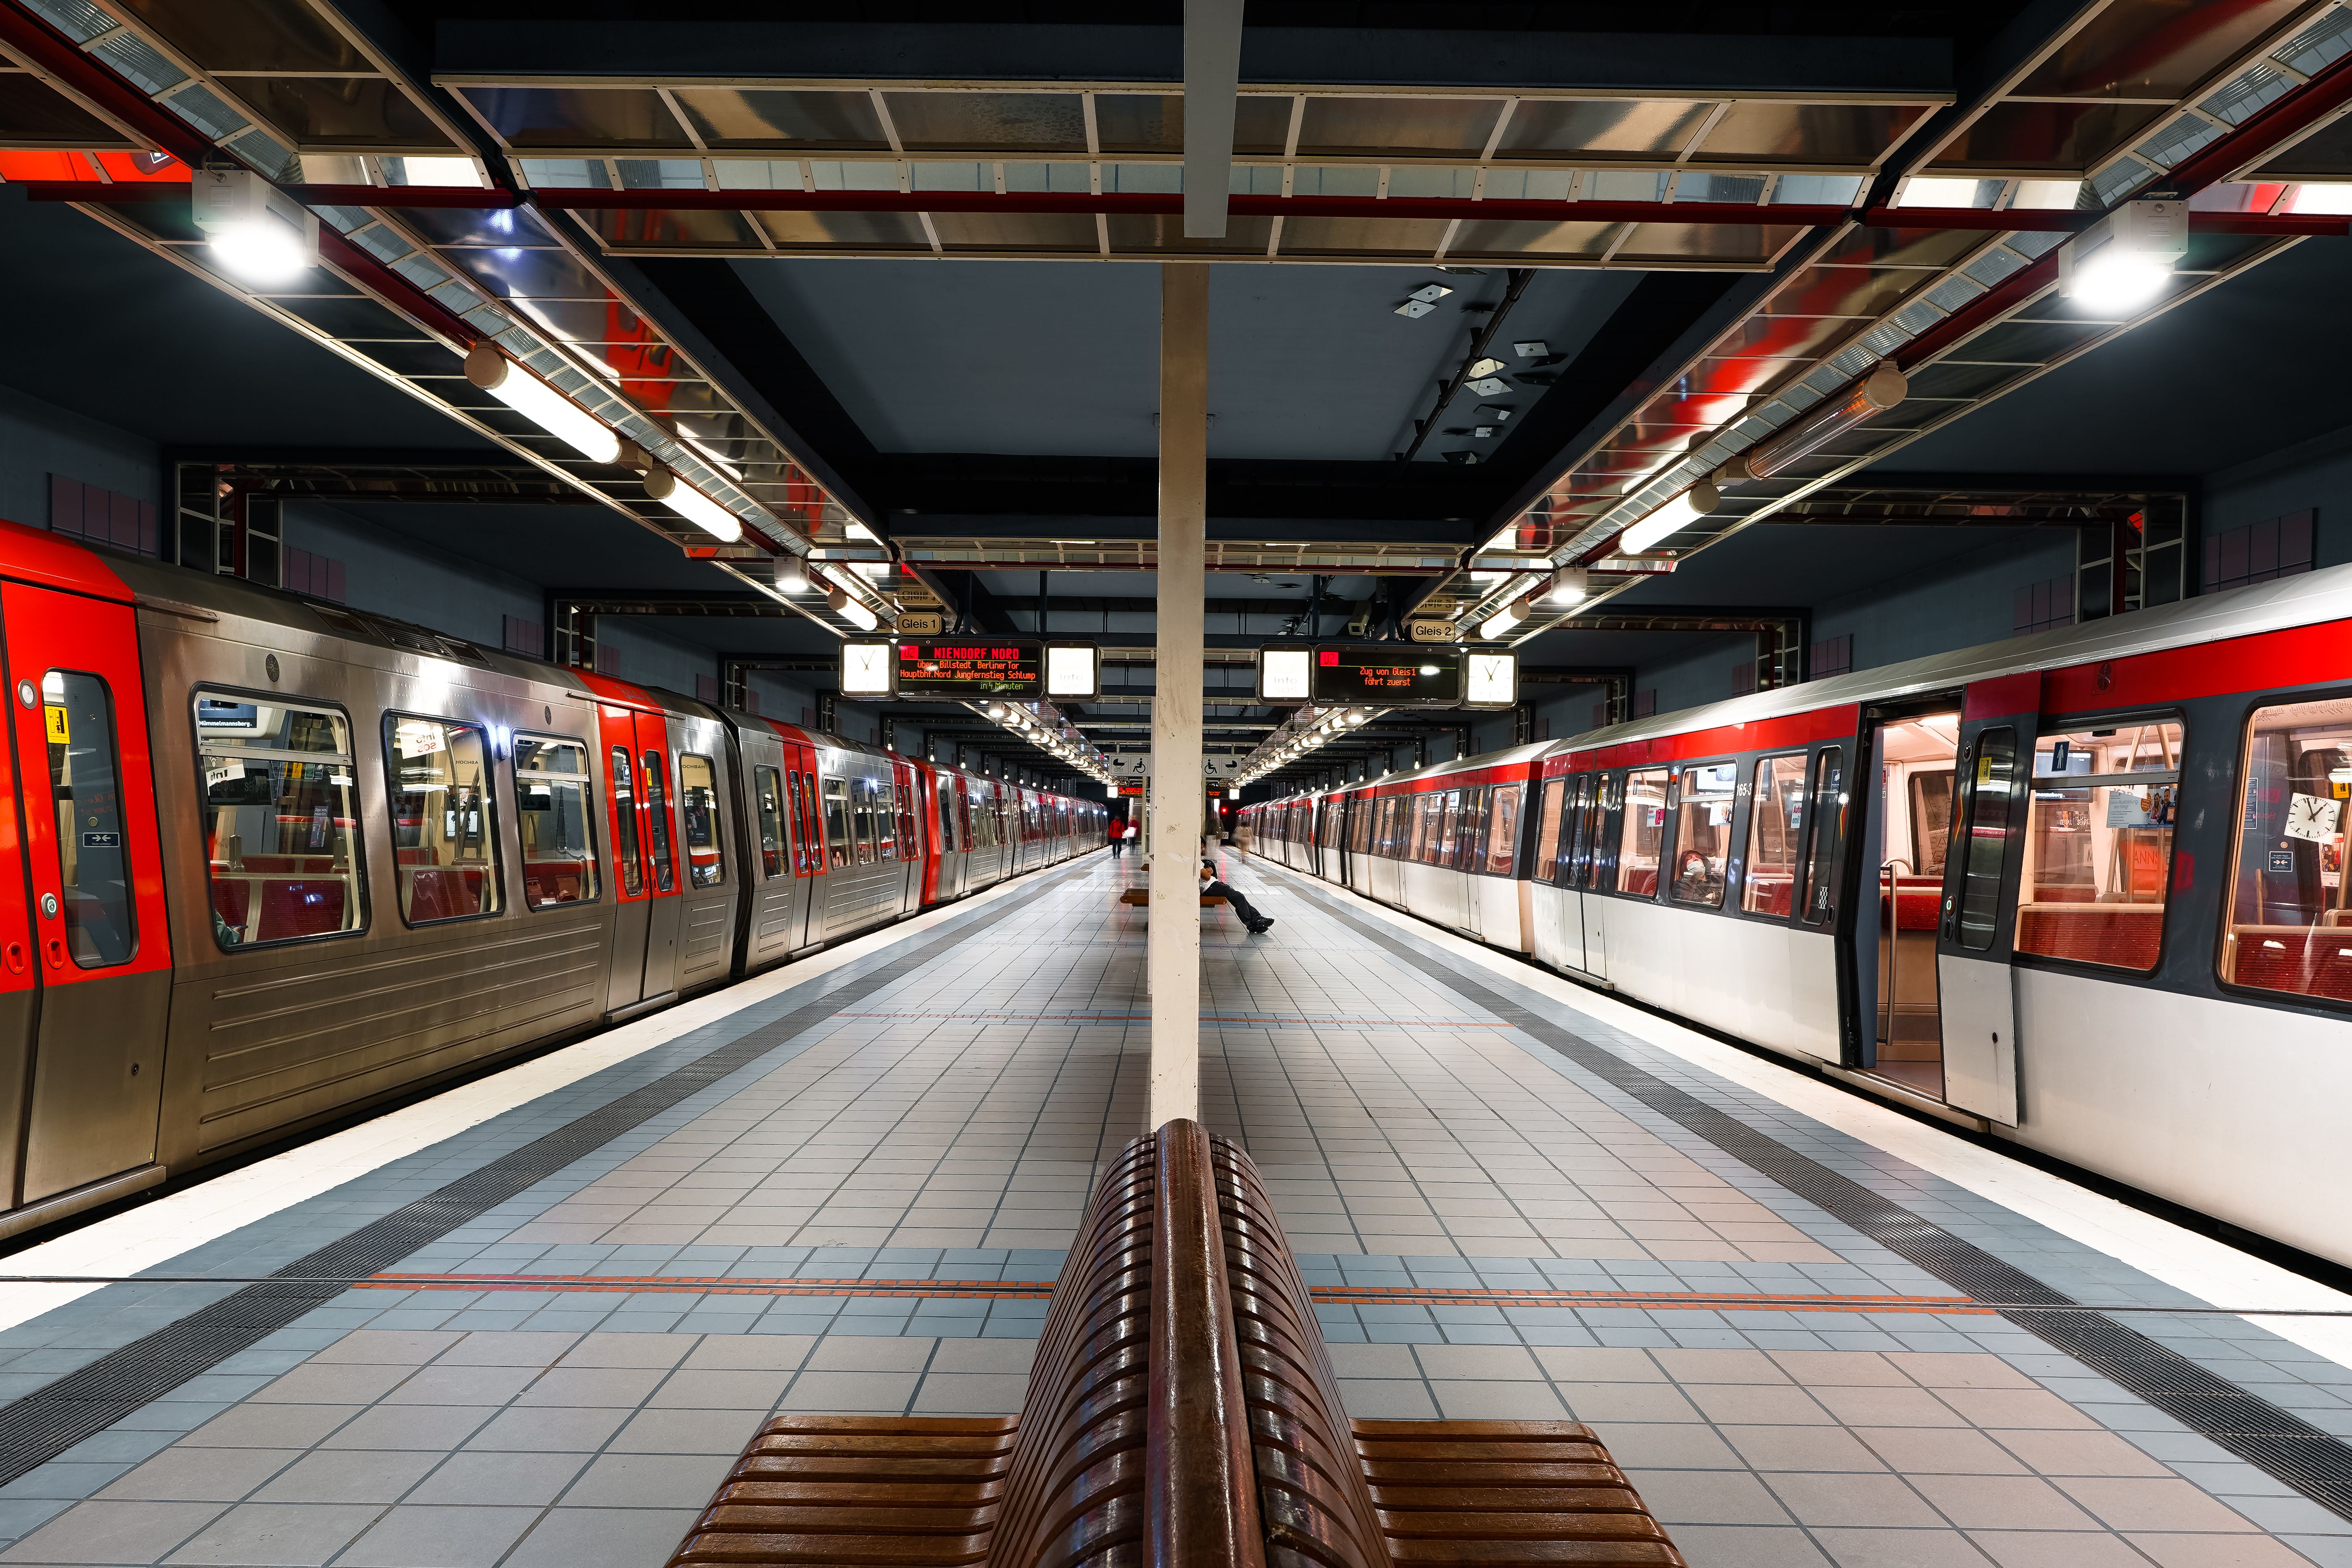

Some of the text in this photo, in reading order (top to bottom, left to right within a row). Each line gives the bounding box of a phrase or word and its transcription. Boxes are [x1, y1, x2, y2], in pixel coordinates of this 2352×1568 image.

[901, 619, 936, 629] Gleis 1
[1415, 625, 1451, 636] Gleis 2
[934, 647, 1019, 660] NIENDORF NORD
[1324, 653, 1335, 664] U2
[939, 660, 971, 669] Billstedt
[977, 661, 1006, 669] Berliner
[954, 670, 1004, 681] Jungfernstieg
[1008, 671, 1036, 681] Schlump
[1360, 667, 1373, 677] Zug
[1365, 677, 1411, 686] fährt zuerst
[1737, 782, 1752, 796] 165-3
